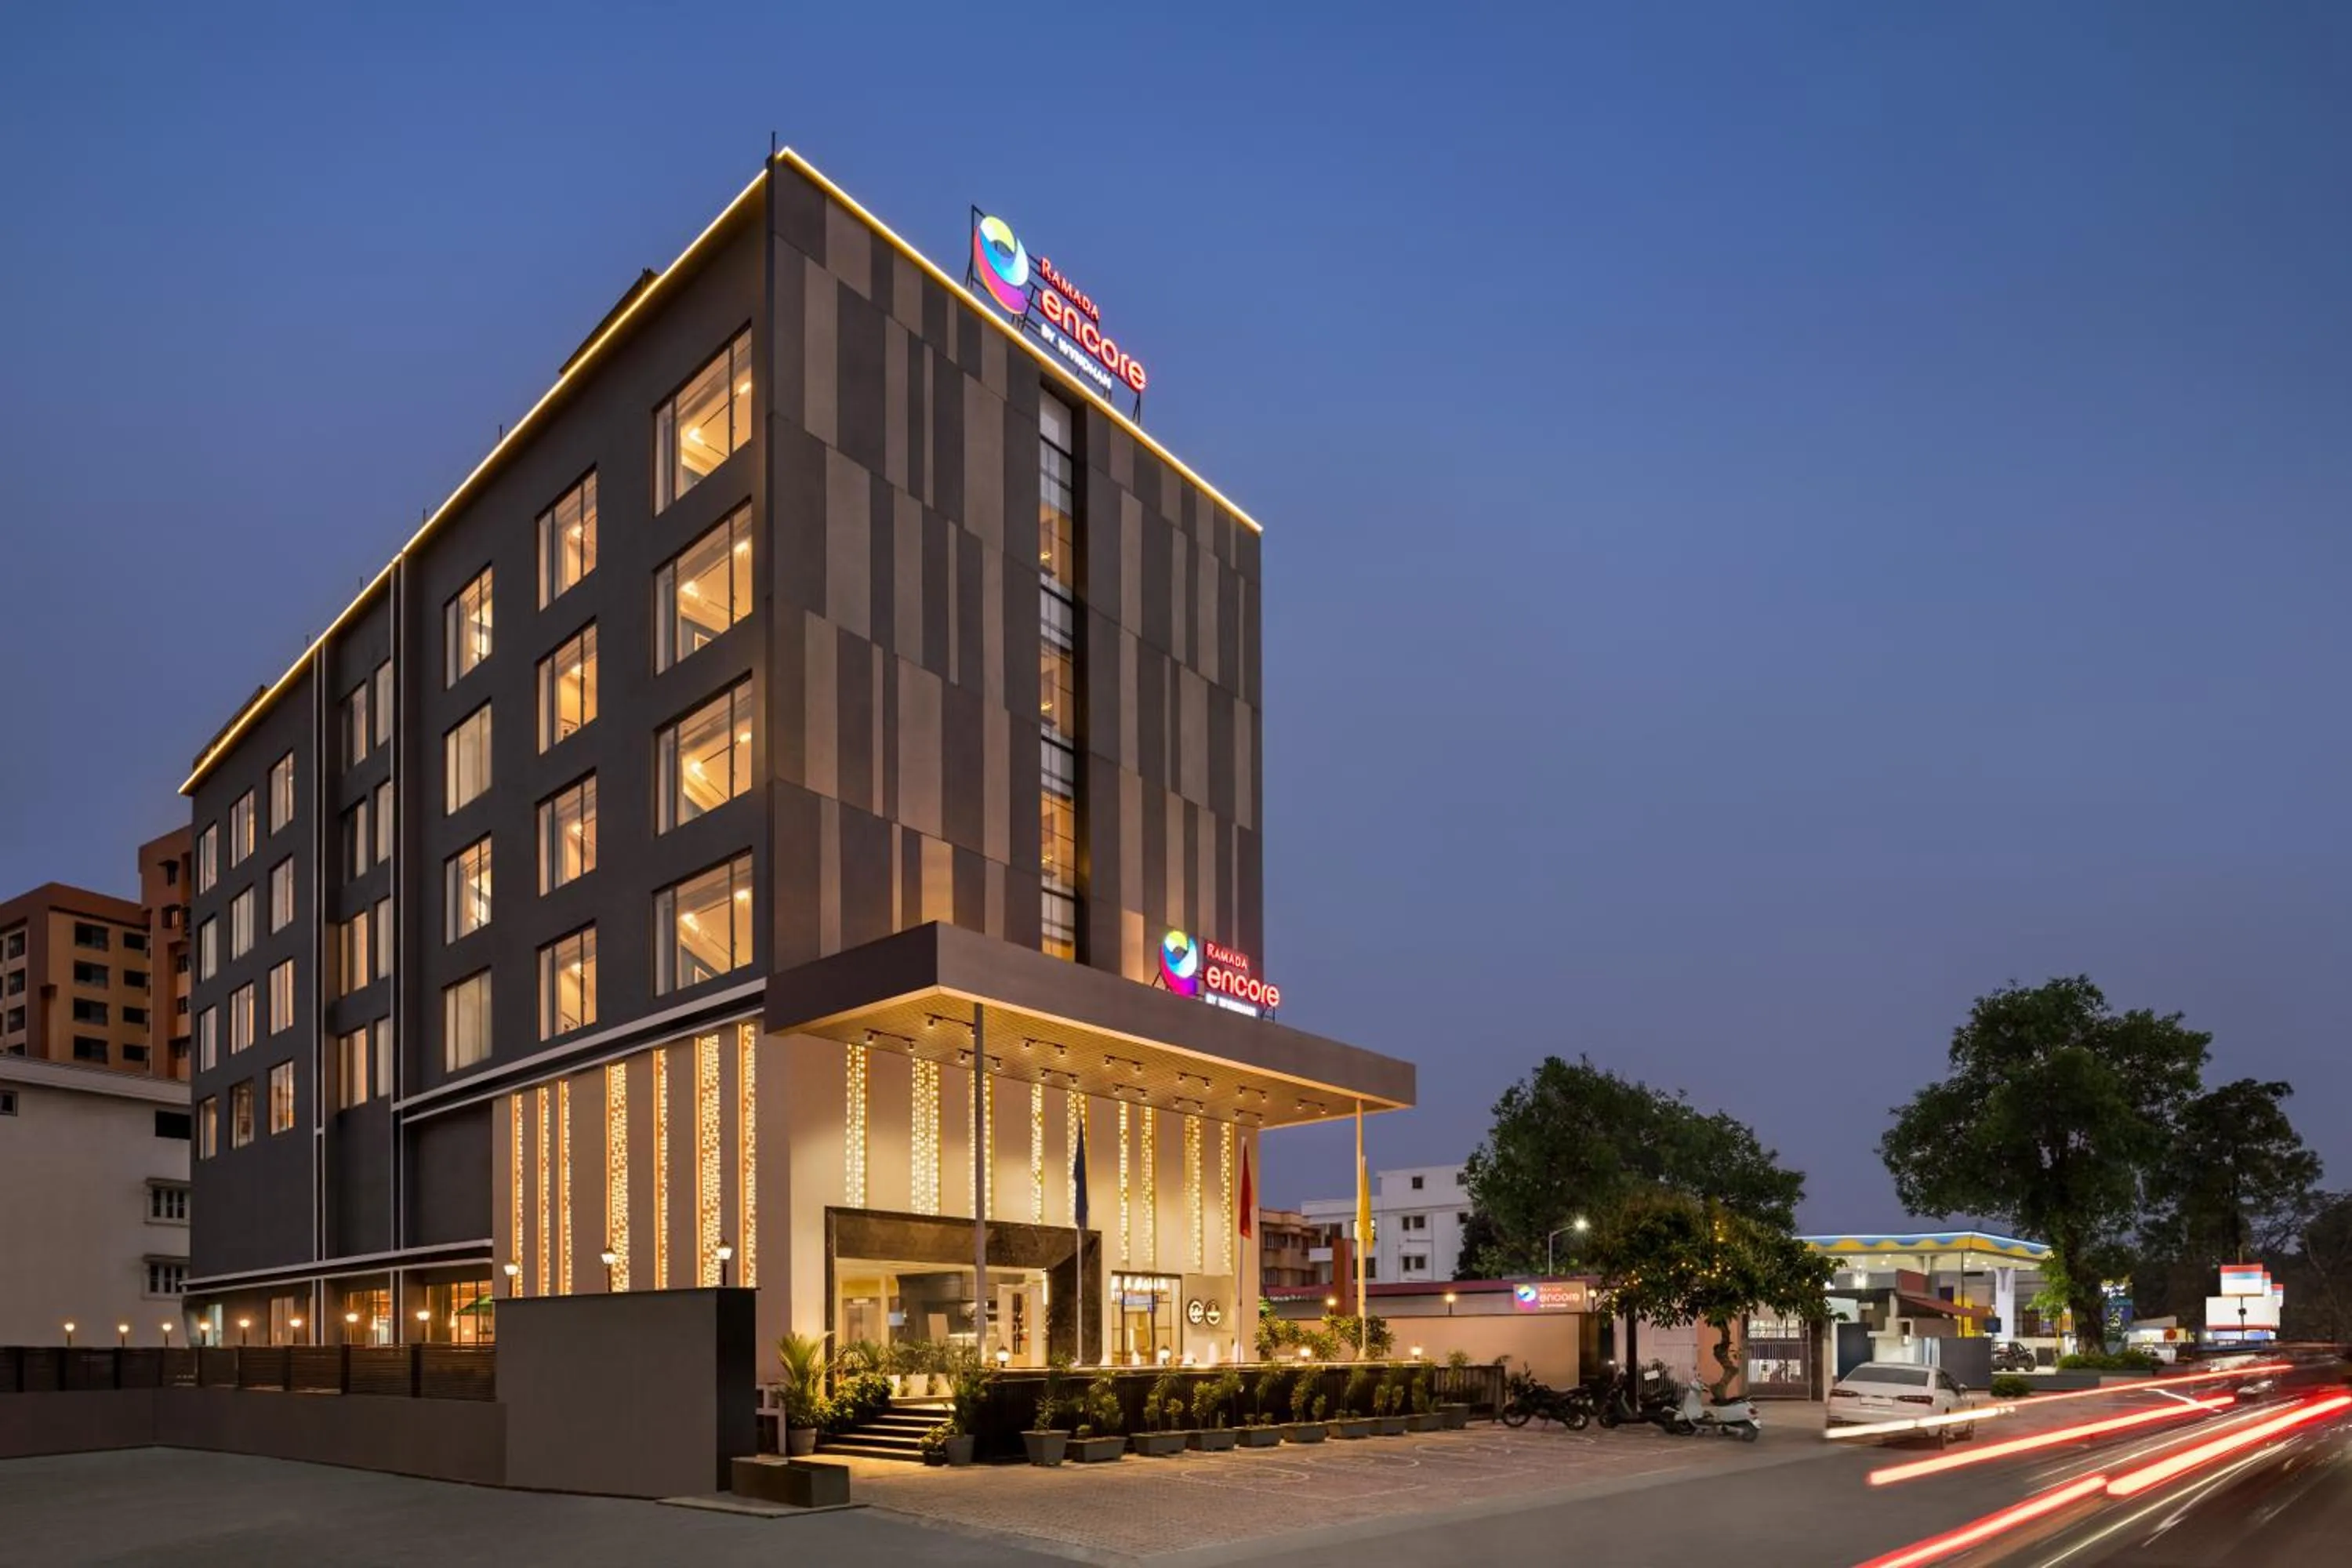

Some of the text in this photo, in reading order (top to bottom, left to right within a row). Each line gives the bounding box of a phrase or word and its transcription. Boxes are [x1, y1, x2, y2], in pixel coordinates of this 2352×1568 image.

[1040, 256, 1100, 320] RAMADA
[1040, 289, 1147, 392] encore
[1206, 942, 1248, 971] RAMADA
[1206, 965, 1281, 1007] encore
